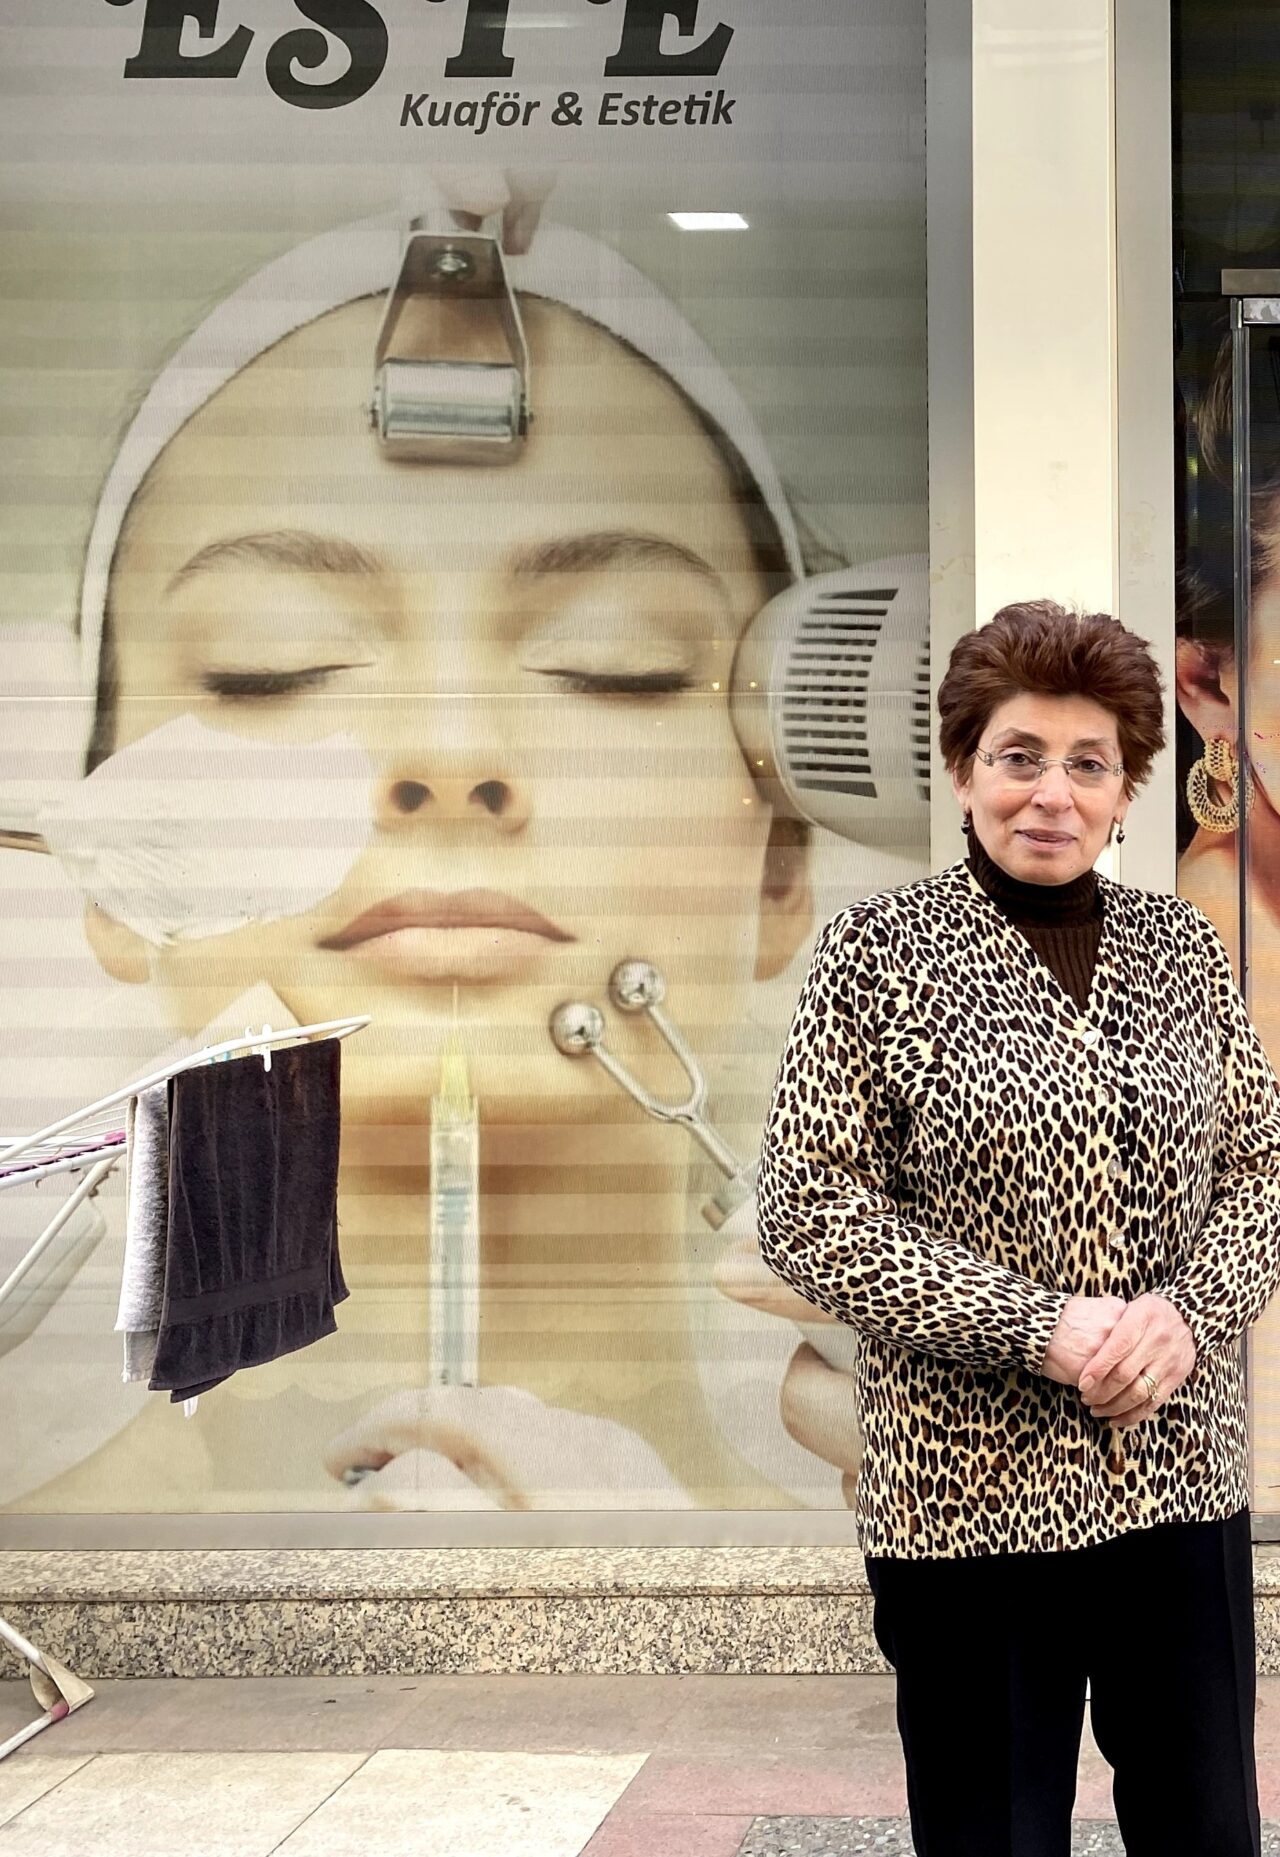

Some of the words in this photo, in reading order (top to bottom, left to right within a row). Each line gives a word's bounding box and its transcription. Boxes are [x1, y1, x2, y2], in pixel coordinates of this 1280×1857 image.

[399, 91, 540, 135] Kuaför
[551, 91, 584, 127] &
[597, 89, 737, 127] Estetik
